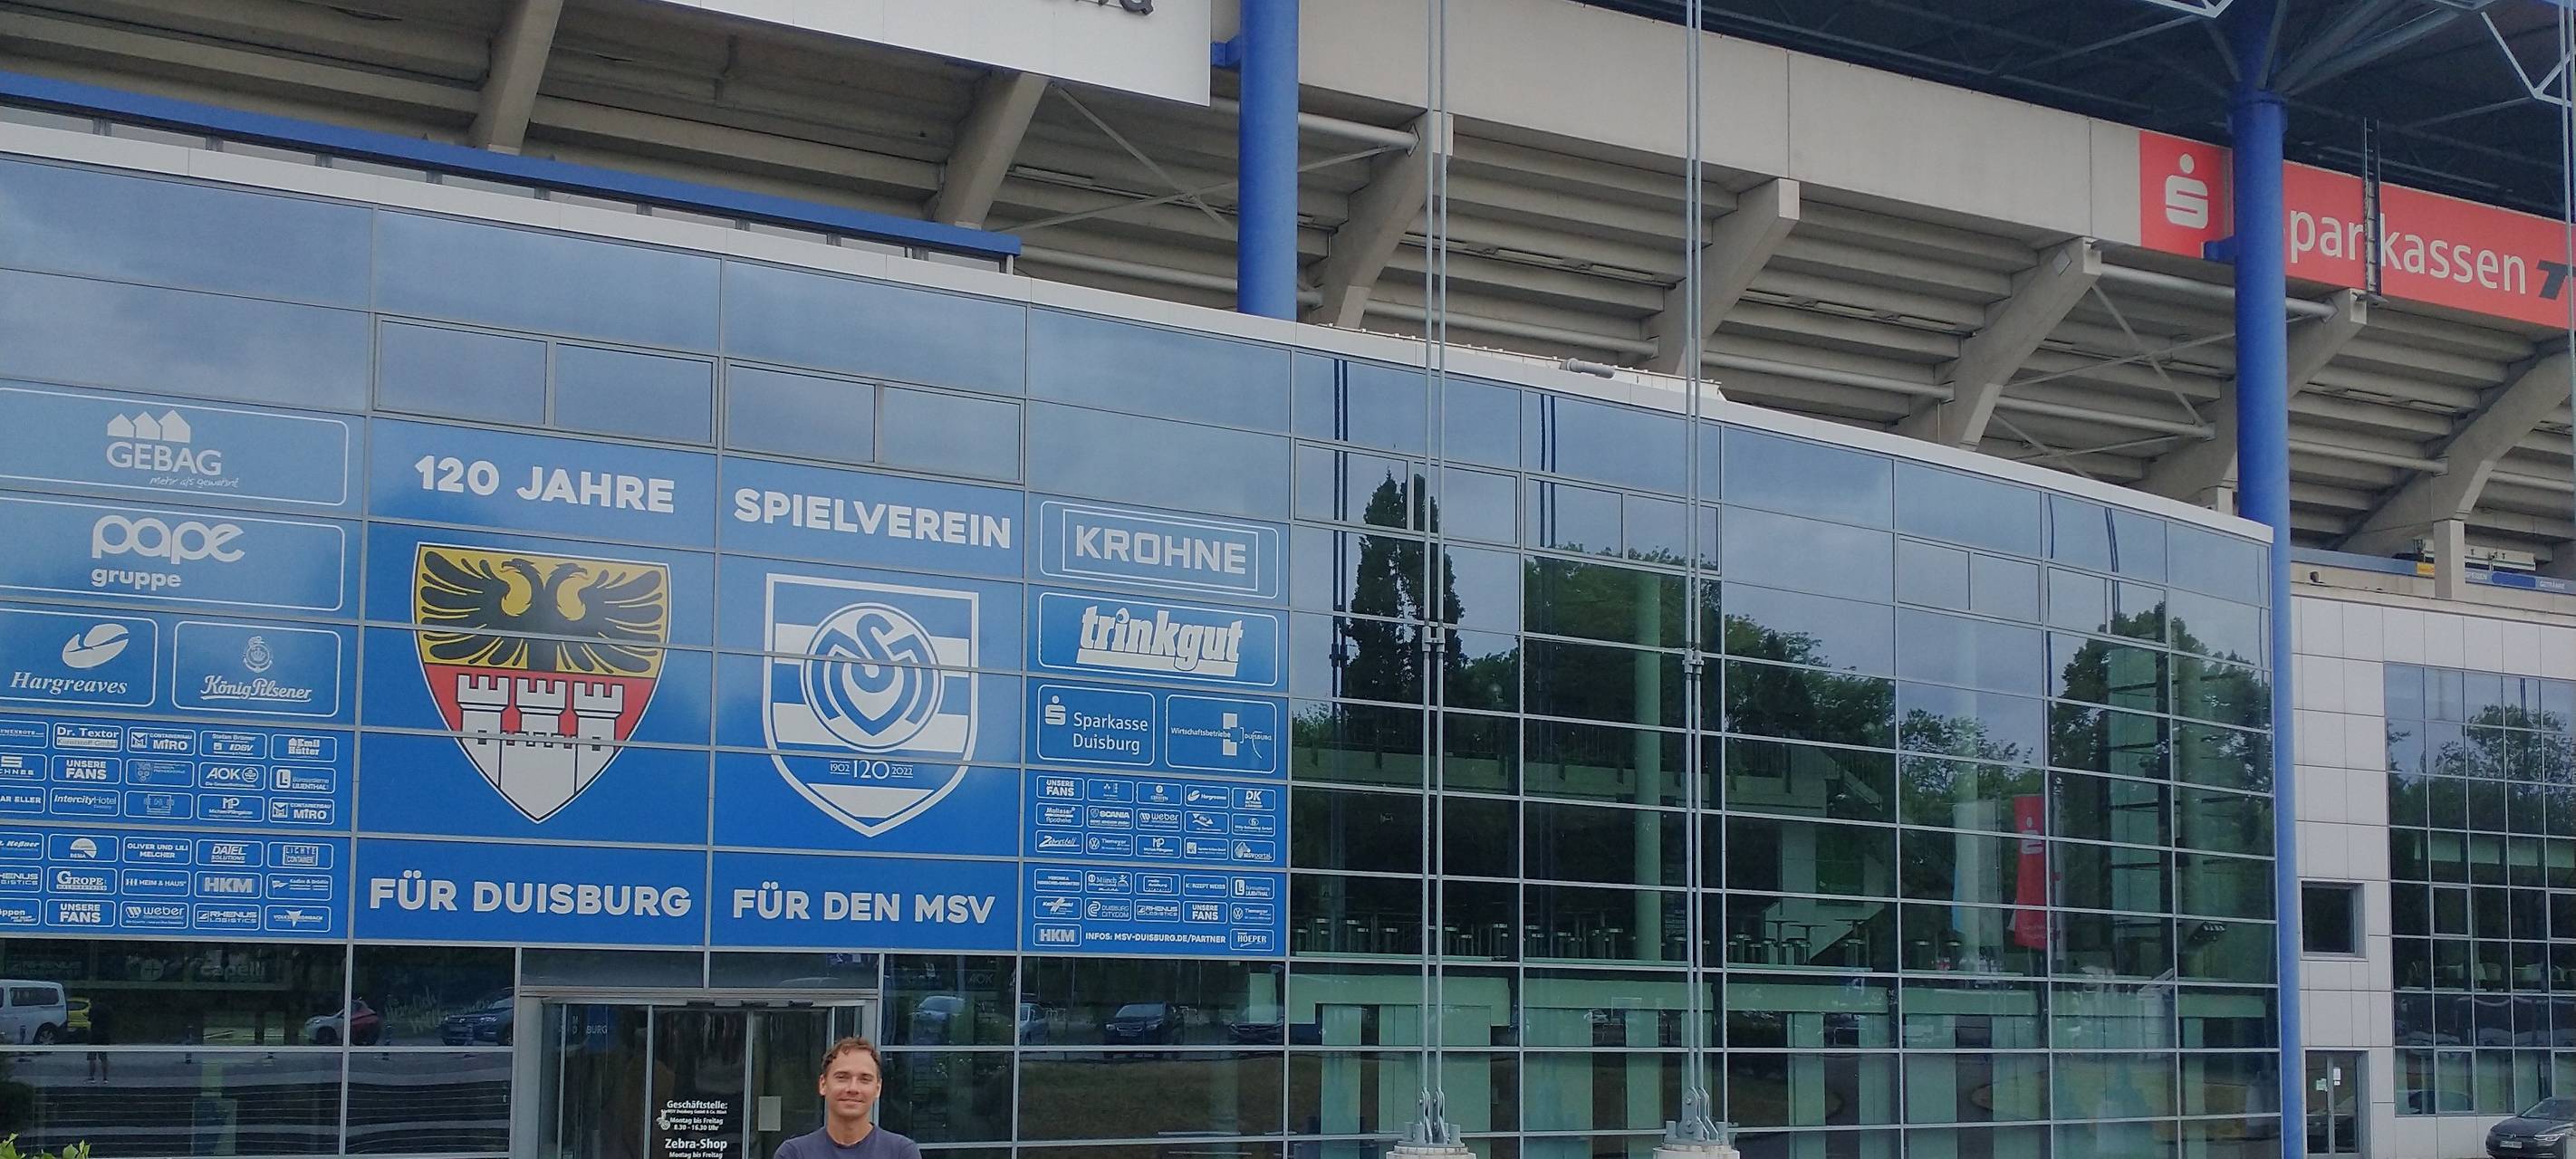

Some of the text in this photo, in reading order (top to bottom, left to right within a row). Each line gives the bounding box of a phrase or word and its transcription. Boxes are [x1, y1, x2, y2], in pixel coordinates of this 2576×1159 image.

[2282, 208, 2526, 294] parkassen
[106, 441, 222, 475] GEBAG
[415, 455, 675, 513] 120 JAHRE
[734, 488, 1012, 549] SPIELVEREIN
[91, 514, 245, 565] pape
[1075, 524, 1246, 575] KROHNE
[91, 568, 182, 591] gruppe
[1079, 605, 1244, 672] trinkgut
[10, 671, 129, 695] Hargreaves
[200, 674, 312, 701] König Pilsener
[1073, 711, 1149, 733] Sparkasse
[57, 726, 120, 739] Dr. Textor
[1072, 732, 1141, 757] Duisburg
[66, 759, 107, 770] UNSERE
[830, 760, 914, 780] 1902 120 2022
[65, 767, 108, 781] FANS
[206, 767, 242, 781] AOK
[1045, 779, 1074, 788] UNSERE
[1045, 786, 1075, 797] FANS
[1245, 790, 1263, 801] DK
[14, 796, 42, 804] ELLER
[54, 794, 117, 806] IntercityHotel
[1099, 810, 1130, 819] SCANIA
[1151, 812, 1179, 821] weber
[204, 876, 254, 894] HKM
[370, 869, 692, 918] FÜR DUISBURG
[60, 902, 101, 912] UNSERE
[732, 880, 996, 924] FÜR DEN MSV
[1192, 904, 1218, 912] UNSERE
[143, 905, 185, 915] weber
[209, 910, 257, 918] RHENUS
[1192, 911, 1218, 921] FANS
[60, 911, 101, 924] FANS
[1040, 928, 1075, 943] HKM
[1085, 932, 1226, 943] INFOS: MSV-DUISBURG.DE/PARTNER
[1237, 934, 1267, 943] HOEPER
[667, 1099, 728, 1110] Geschäftstelle:
[670, 1116, 693, 1125] Montag
[703, 1116, 724, 1125] Freitag
[665, 1137, 727, 1152] Zebra-Shop
[669, 1151, 692, 1159] Montag
[702, 1151, 724, 1159] Freitag
